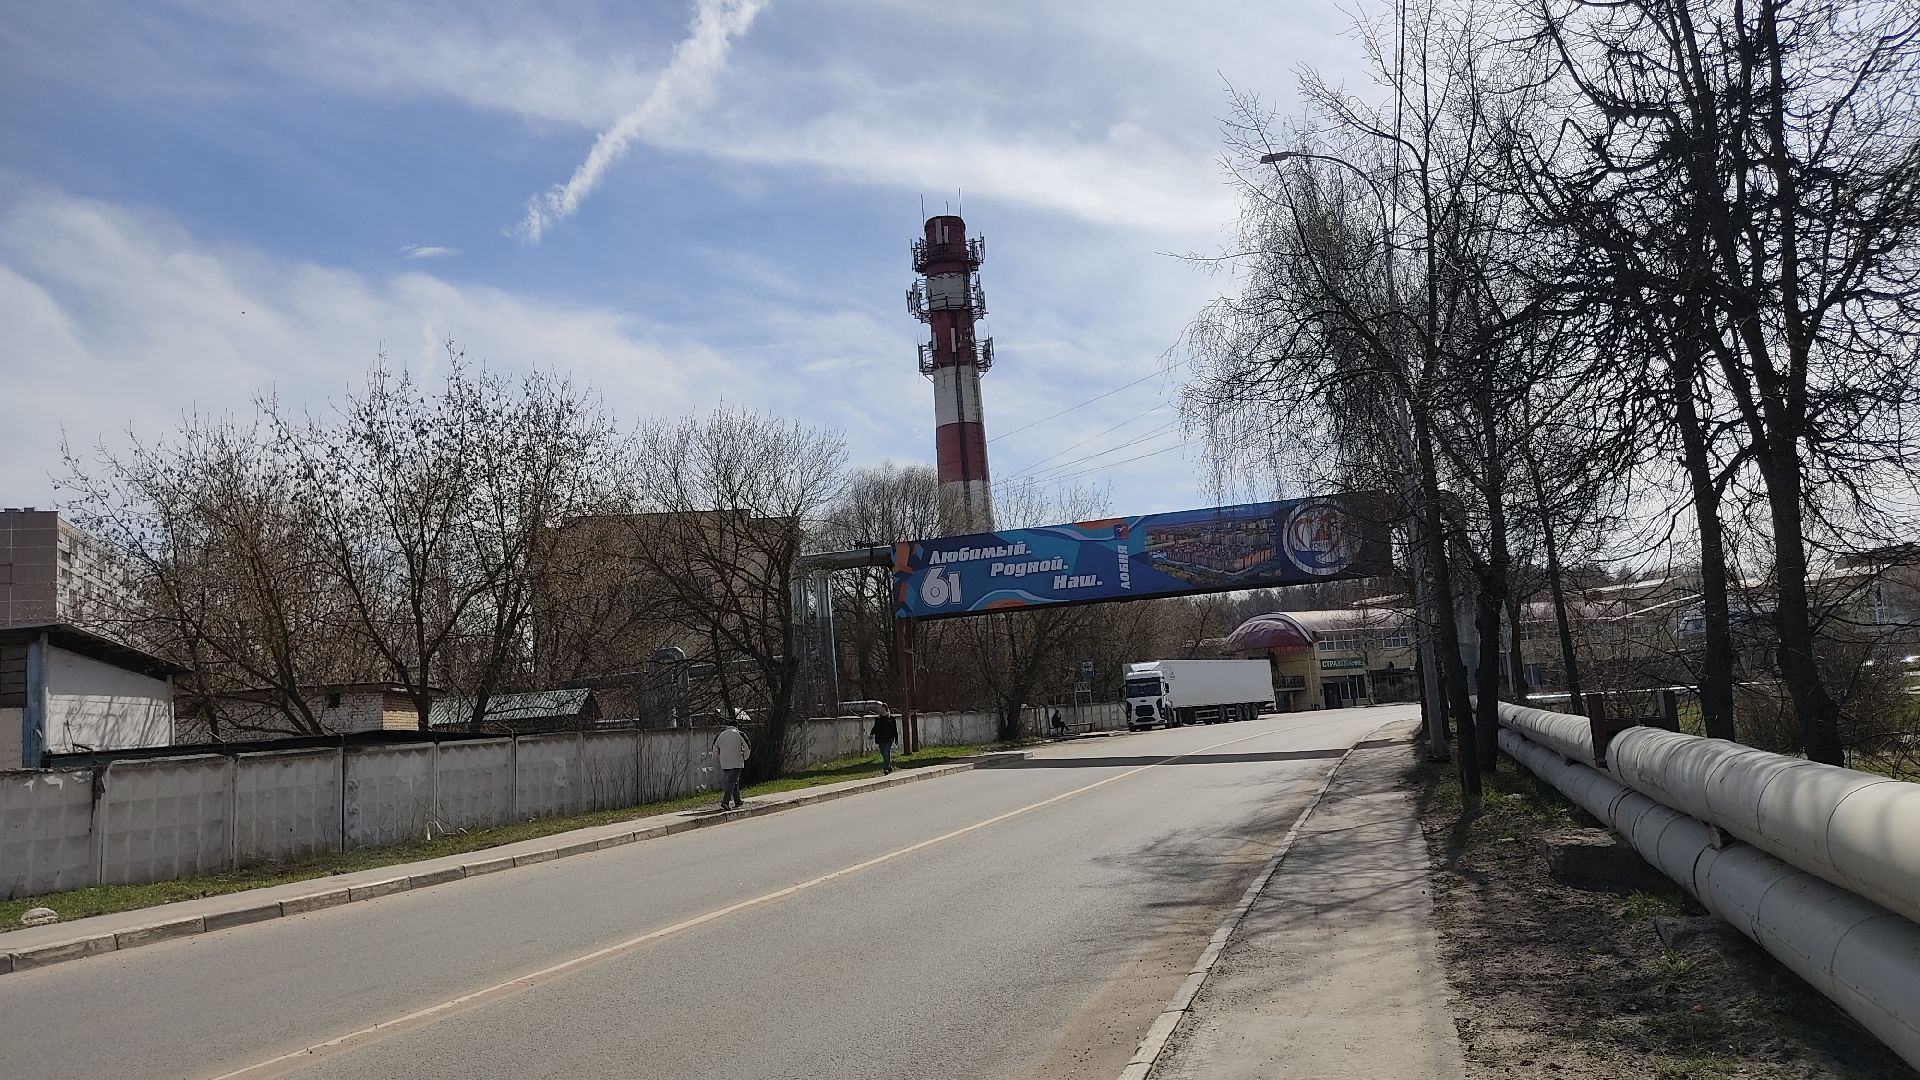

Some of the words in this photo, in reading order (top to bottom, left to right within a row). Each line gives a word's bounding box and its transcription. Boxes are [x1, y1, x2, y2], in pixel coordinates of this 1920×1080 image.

[929, 541, 1032, 564] Любимый.
[991, 556, 1069, 577] Родной.
[1117, 545, 1131, 589] ЛОБНЯ
[920, 565, 963, 608] 61
[1053, 574, 1102, 589] Наш.
